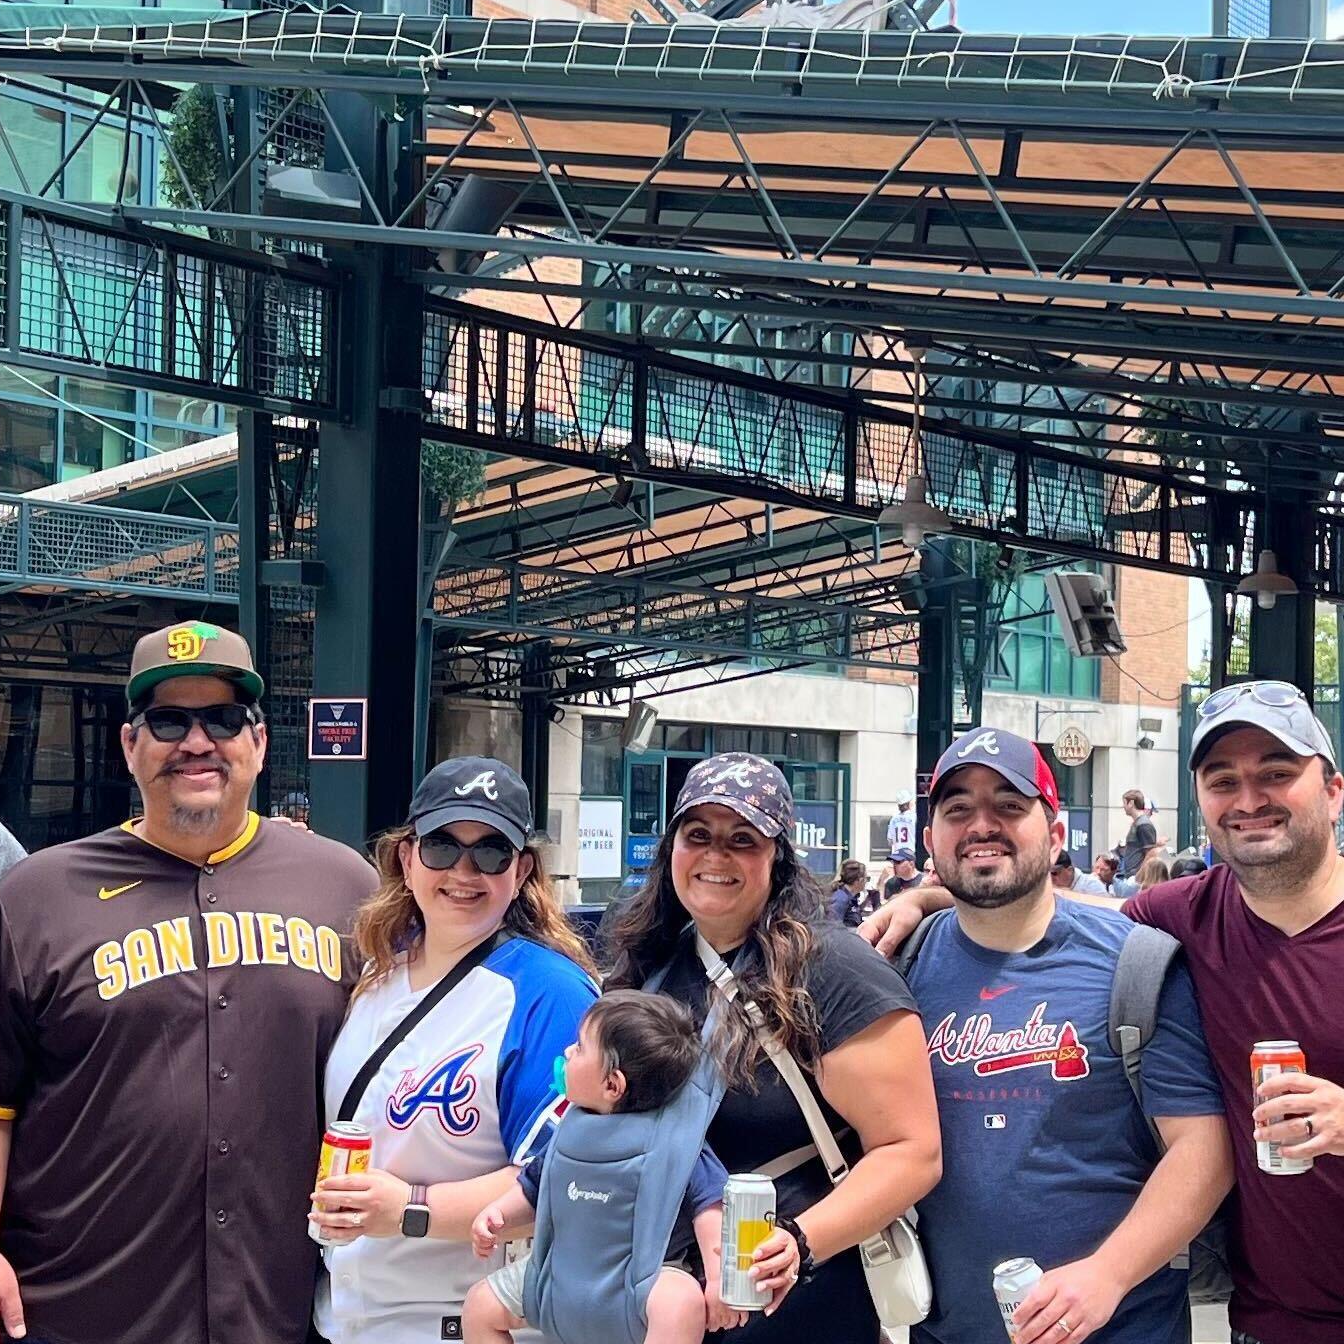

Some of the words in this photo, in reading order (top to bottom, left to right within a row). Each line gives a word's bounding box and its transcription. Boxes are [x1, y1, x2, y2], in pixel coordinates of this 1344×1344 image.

[957, 731, 1000, 758] A
[454, 770, 499, 800] A
[594, 840, 614, 850] BEER
[894, 826, 909, 843] 13
[92, 916, 199, 1002] SAN
[201, 911, 343, 983] DIEGO
[928, 1001, 1057, 1065] Atlanta
[386, 1043, 484, 1137] A
